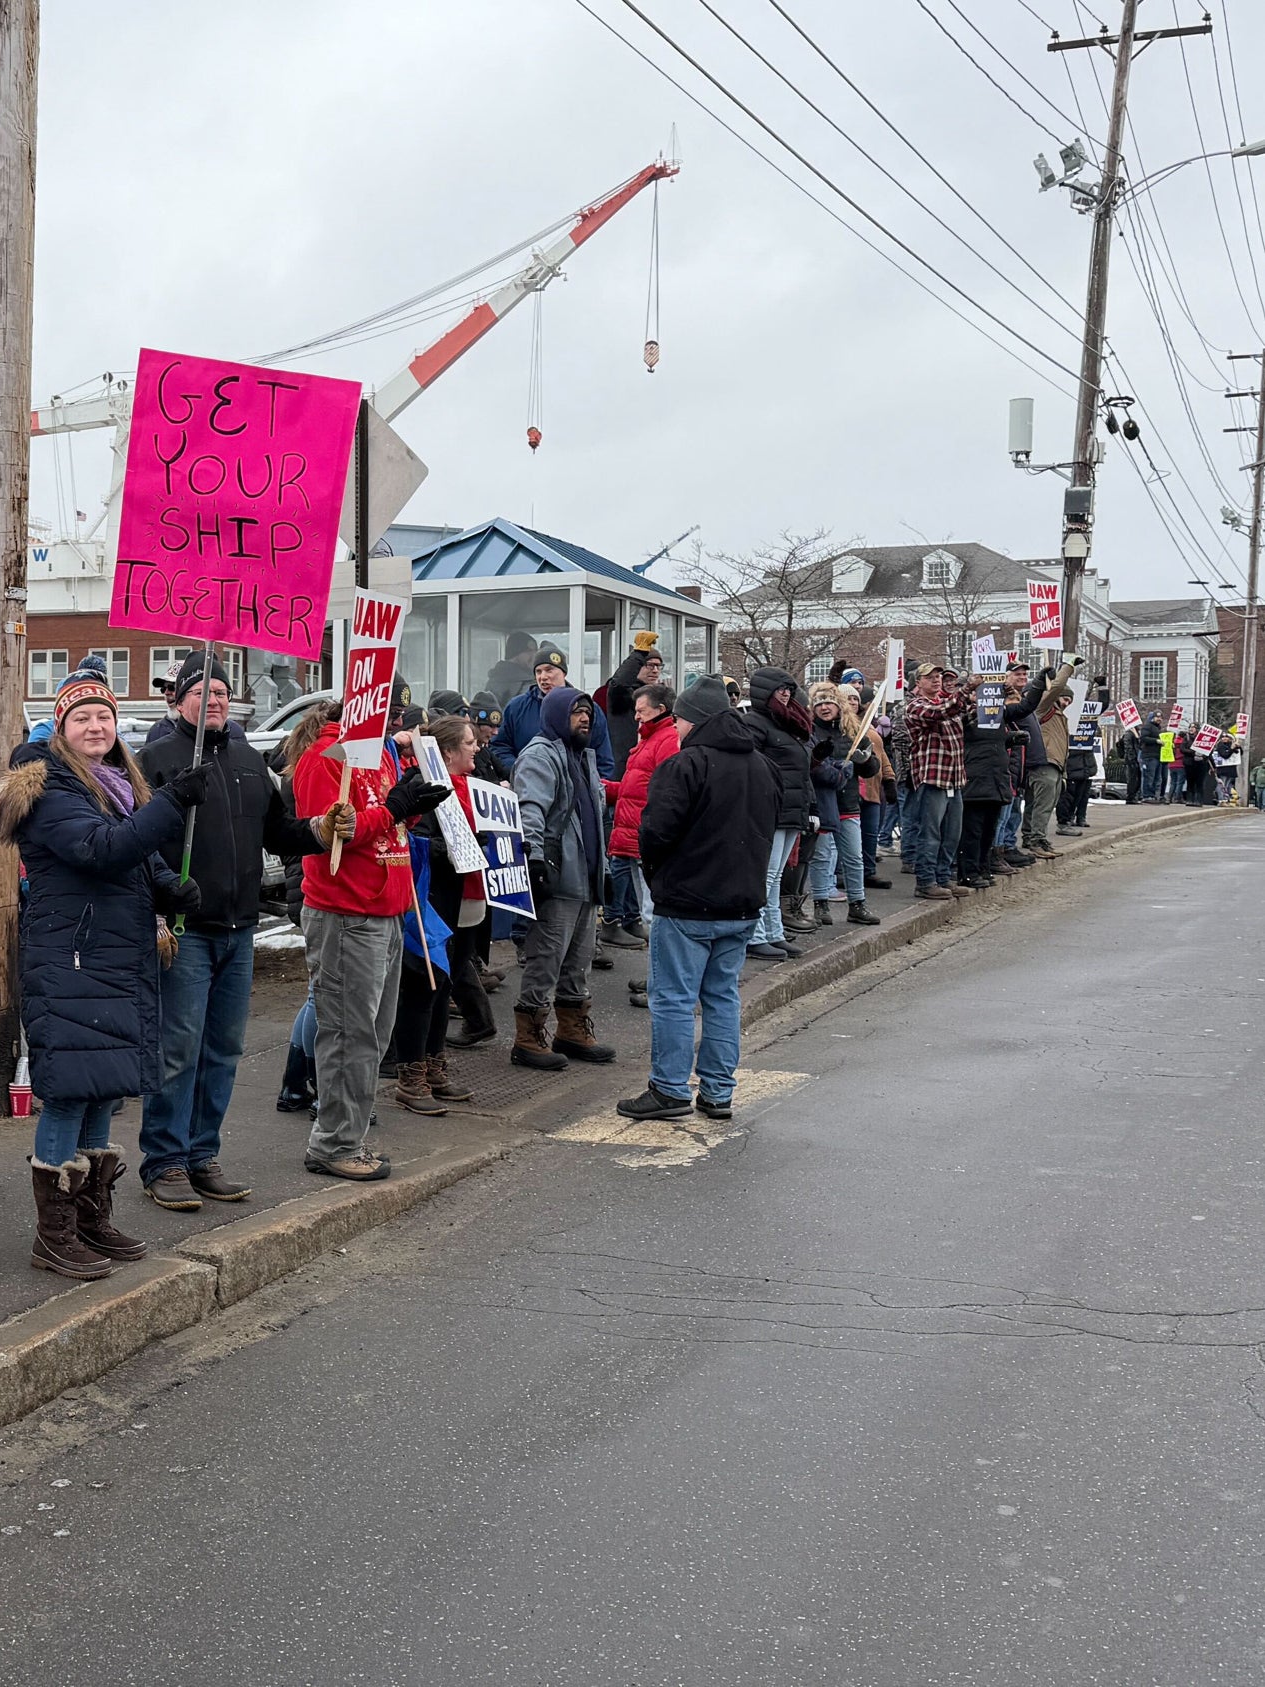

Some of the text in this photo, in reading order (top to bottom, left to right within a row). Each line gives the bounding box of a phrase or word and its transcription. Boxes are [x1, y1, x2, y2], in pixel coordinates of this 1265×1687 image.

[157, 361, 301, 438] GET
[154, 430, 311, 510] YOUR
[160, 507, 304, 570] SHIP
[116, 559, 314, 648] TOGETHER
[1030, 583, 1058, 600] UAW
[353, 596, 402, 642] UAW
[1031, 615, 1061, 638] STRIKE
[1036, 604, 1049, 620] ON
[352, 652, 376, 693] ON
[978, 655, 1002, 672] UAW
[983, 687, 1001, 696] COLA
[1082, 703, 1097, 714] AW
[339, 682, 391, 740] STRIKE
[473, 788, 517, 829] UAW
[496, 836, 515, 865] ON
[487, 865, 529, 897] STRIKE
